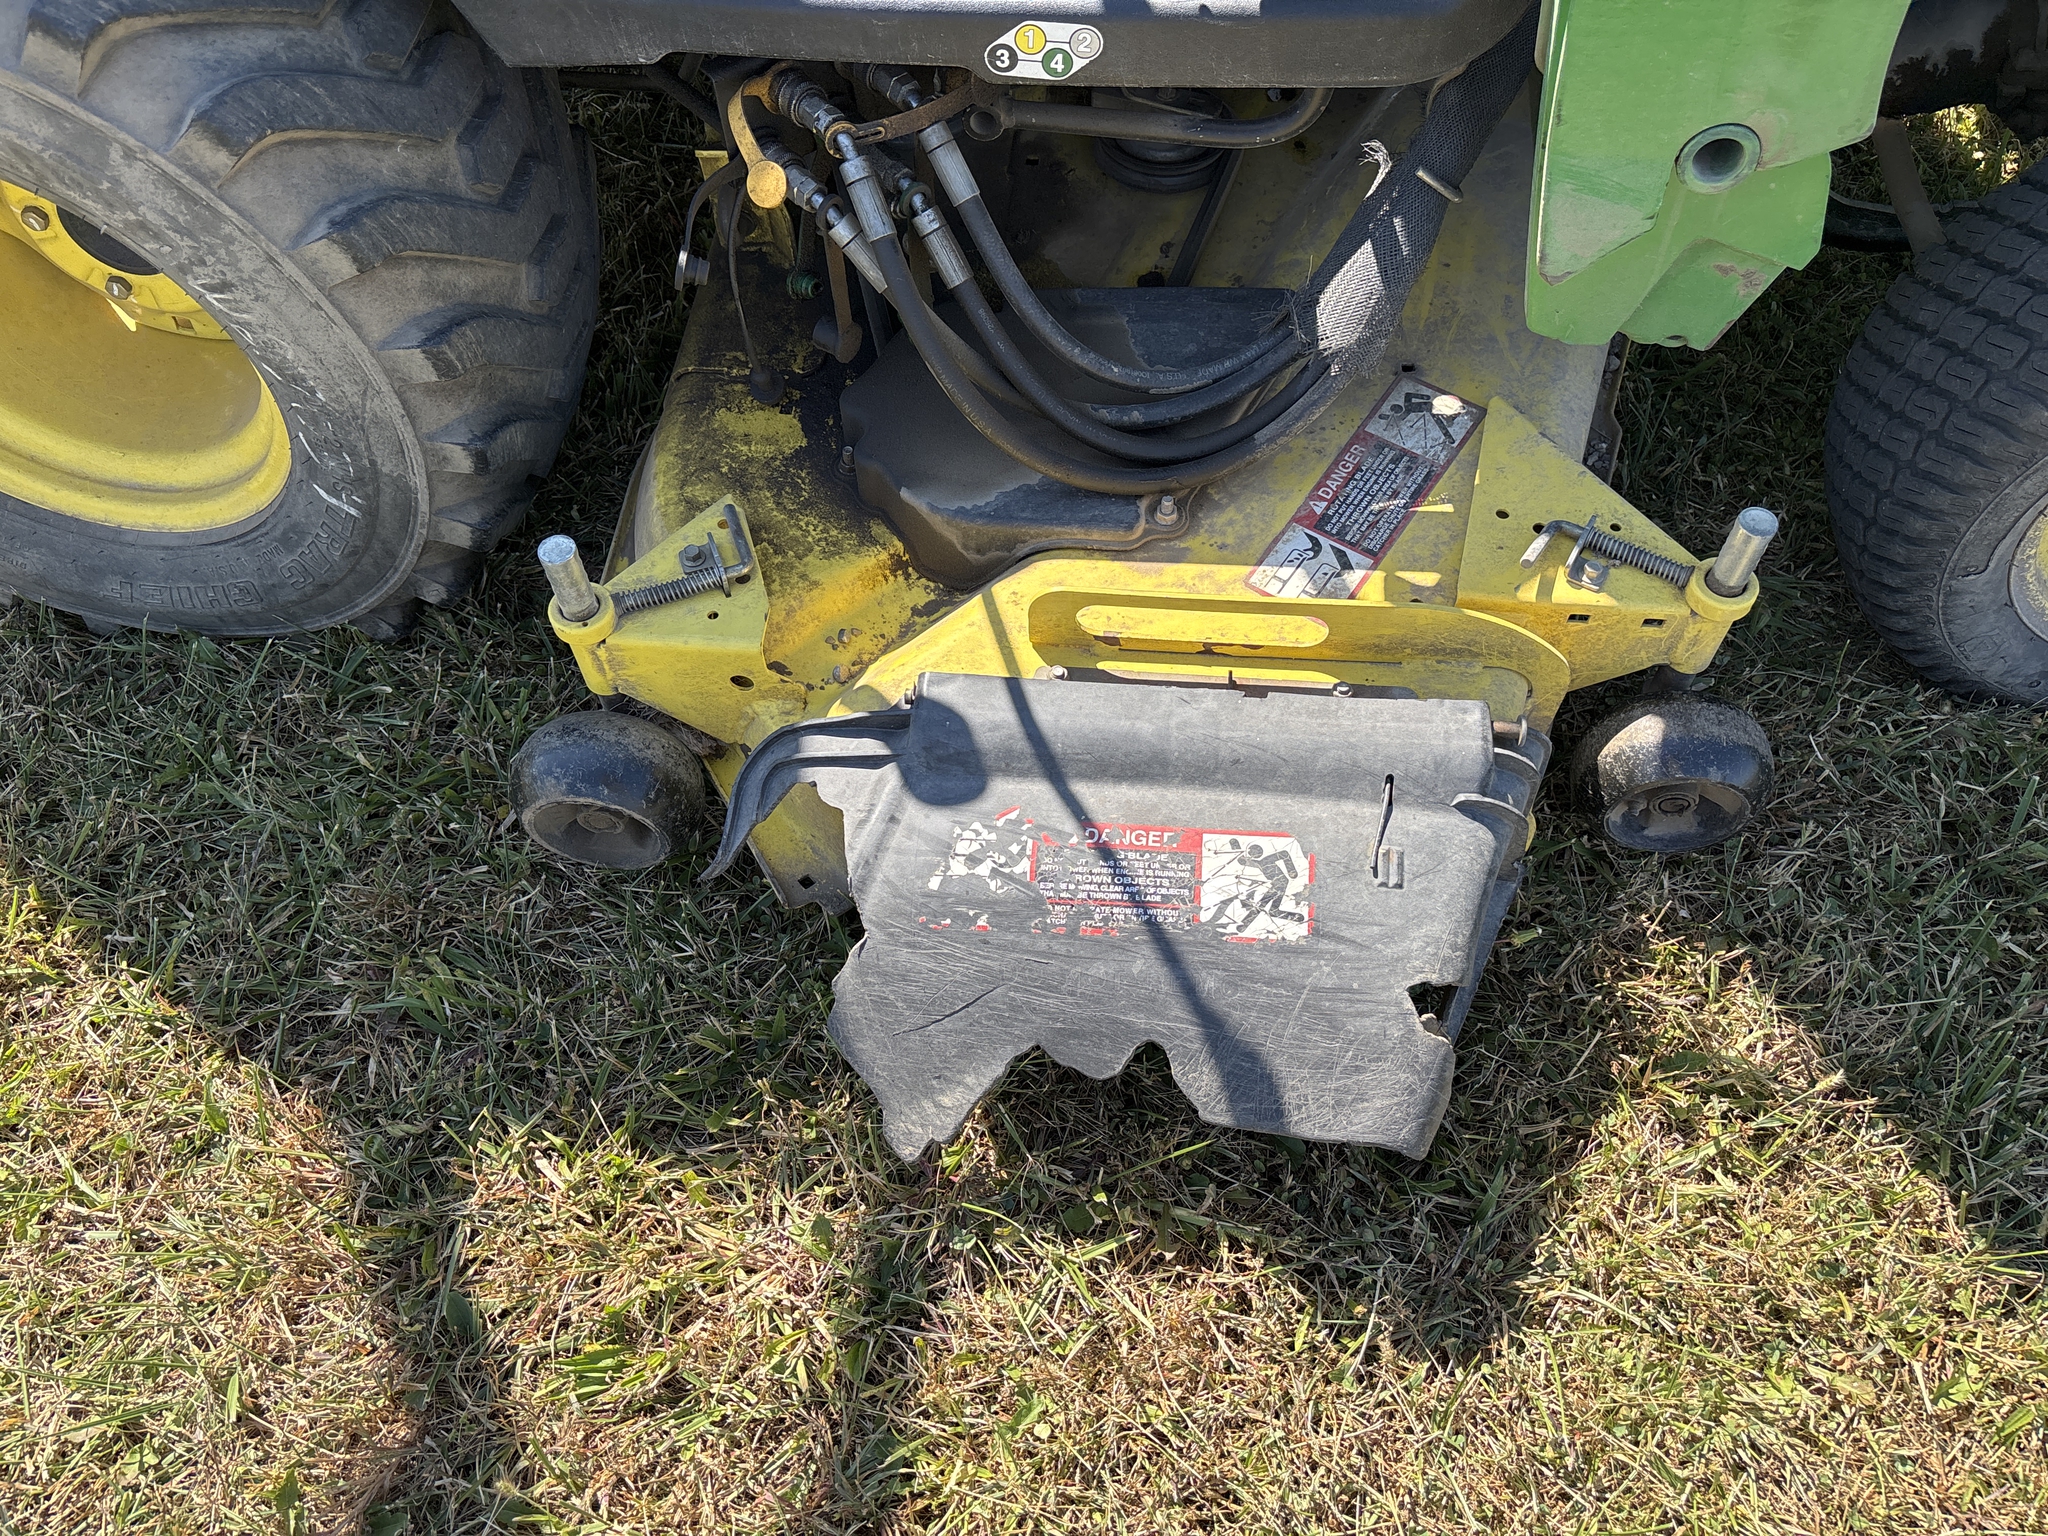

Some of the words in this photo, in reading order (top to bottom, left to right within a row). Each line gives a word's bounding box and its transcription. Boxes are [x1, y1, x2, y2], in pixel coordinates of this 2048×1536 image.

[1023, 28, 1035, 50] 1
[1076, 32, 1093, 54] 2
[995, 48, 1010, 69] 3
[1049, 53, 1065, 73] 4
[1317, 443, 1366, 499] DANGER
[1353, 456, 1374, 479] BLADE
[1324, 522, 1333, 531] DO
[1330, 512, 1340, 524] NOT
[1337, 503, 1347, 513] PUT
[1344, 487, 1359, 504] HANDS
[1356, 480, 1365, 488] OR
[1361, 469, 1373, 481] FEET
[1345, 494, 1372, 525] THROWN
[1368, 463, 1395, 495] OBJECTS
[1330, 522, 1342, 534] INTO
[1339, 504, 1355, 522] MOWER
[1352, 490, 1365, 504] WHEN
[279, 503, 357, 591] TRAC
[1350, 530, 1362, 543] THAT
[101, 579, 264, 609] CHIEF
[1075, 874, 1112, 884] ROWN
[1114, 876, 1170, 887] OBJECTS
